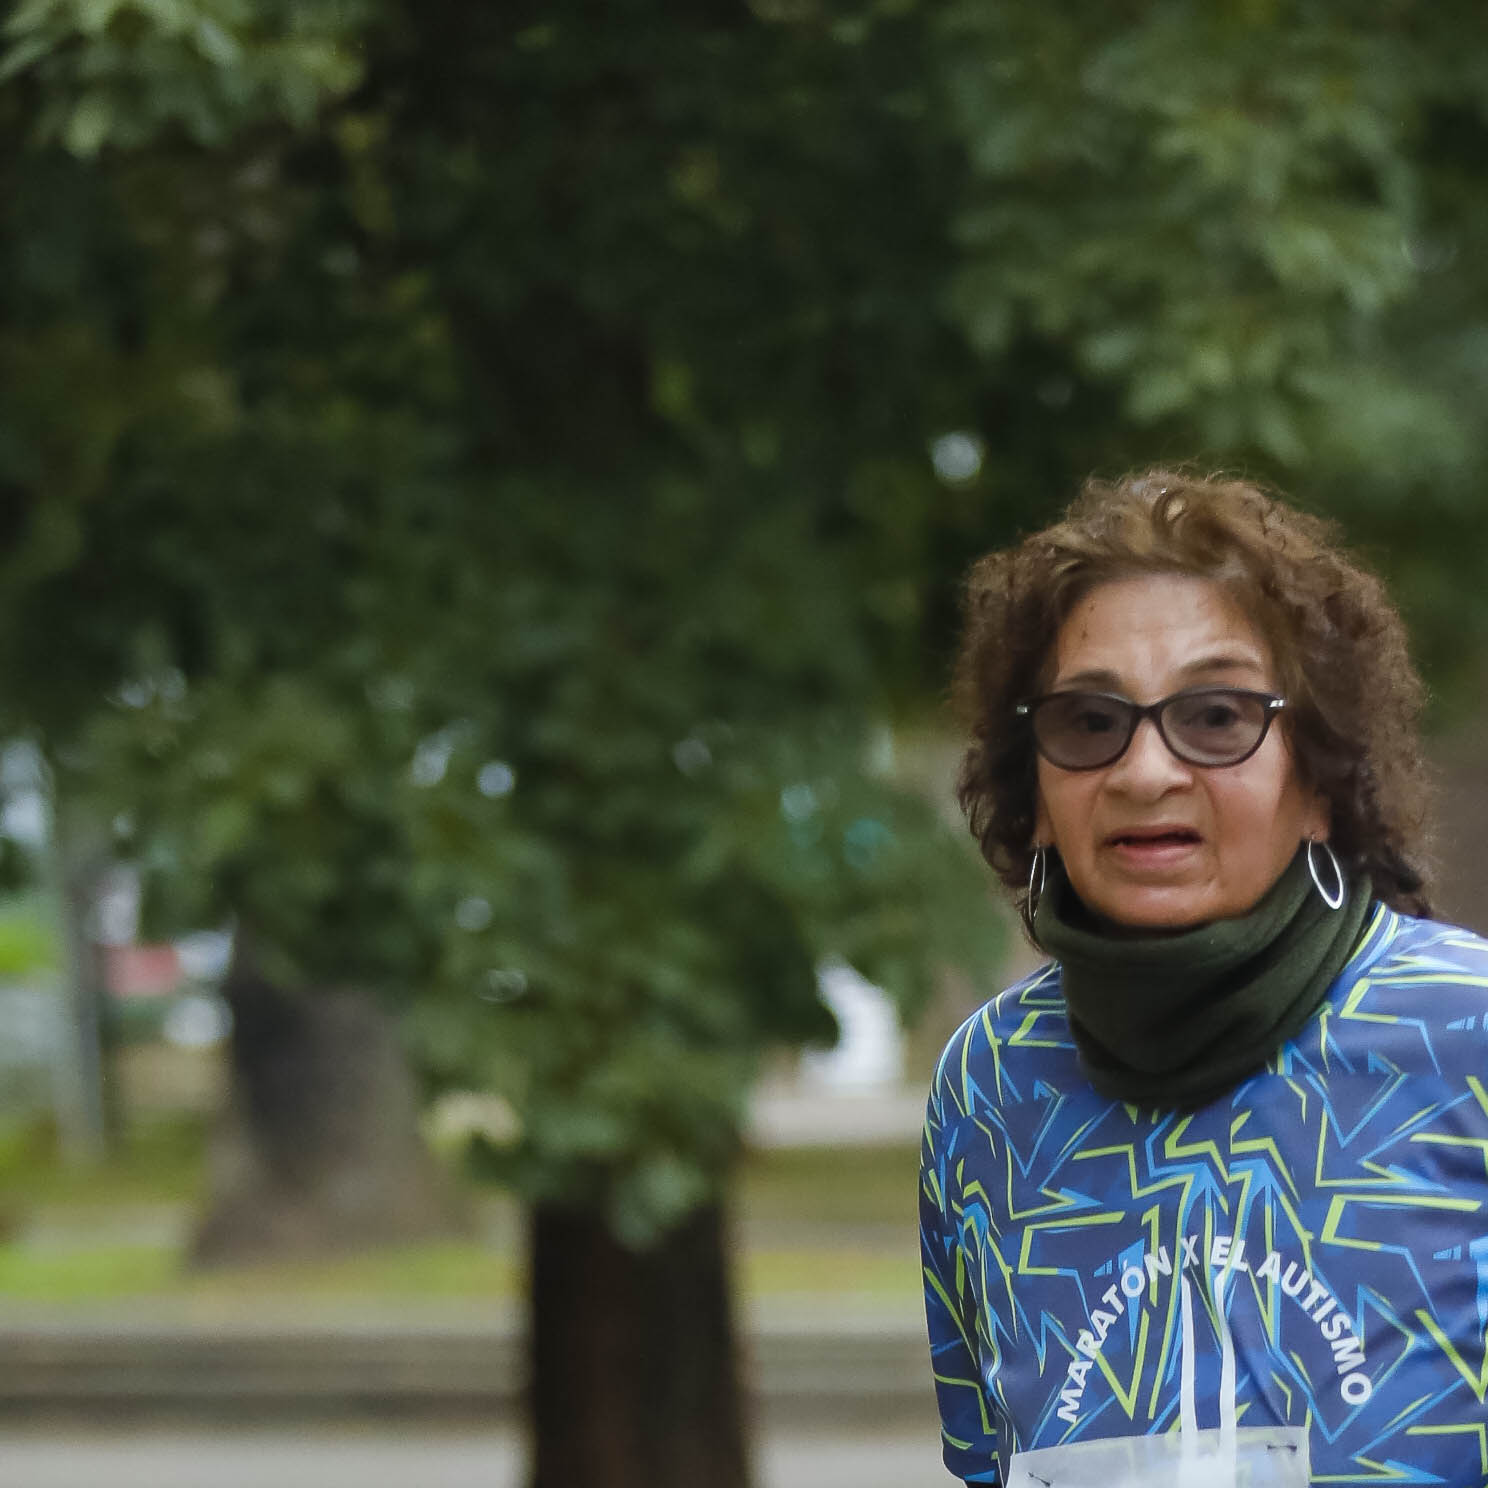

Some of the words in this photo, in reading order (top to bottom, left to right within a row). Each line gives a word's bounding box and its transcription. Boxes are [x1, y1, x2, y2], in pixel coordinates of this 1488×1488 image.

[1057, 1246, 1172, 1423] MARATÓN
[1180, 1235, 1200, 1268] X
[1210, 1236, 1249, 1271] EL
[1256, 1251, 1373, 1405] AUTISMO
